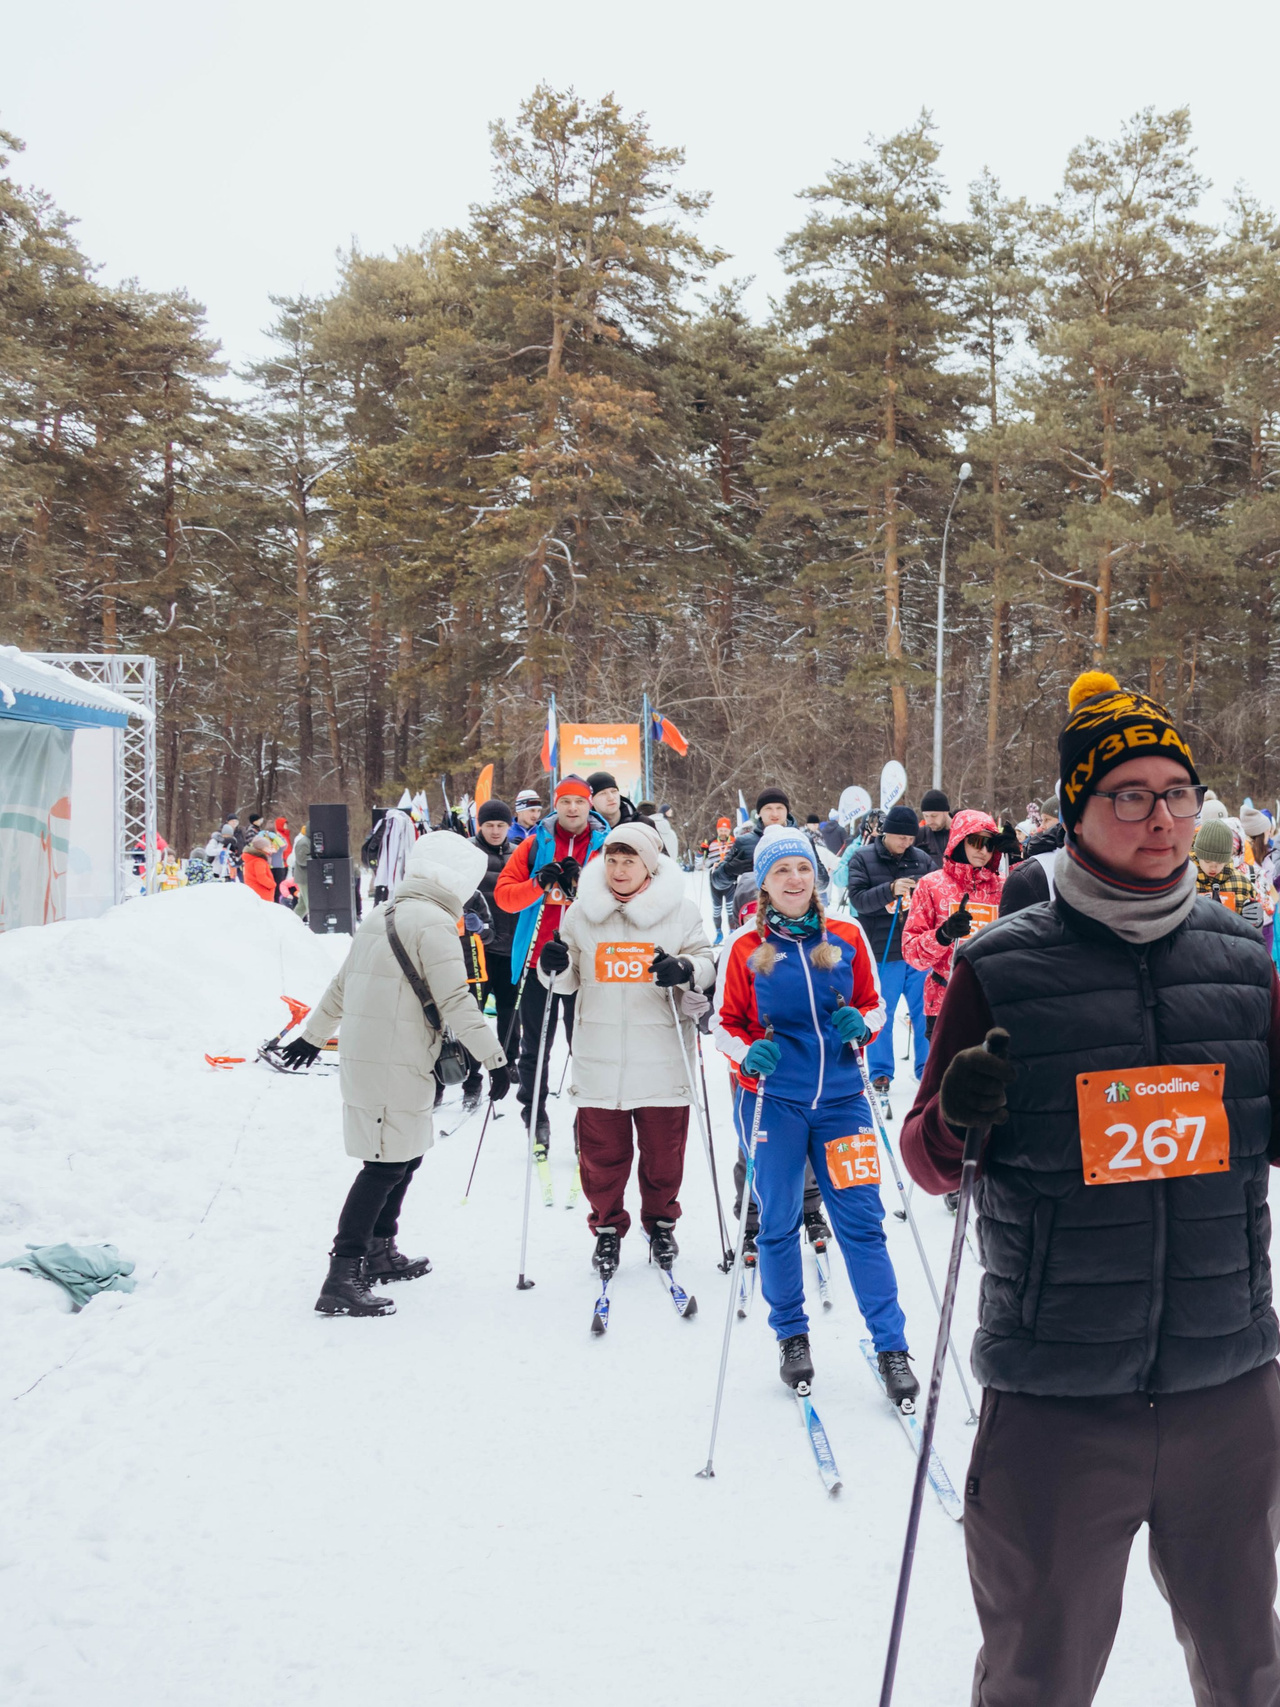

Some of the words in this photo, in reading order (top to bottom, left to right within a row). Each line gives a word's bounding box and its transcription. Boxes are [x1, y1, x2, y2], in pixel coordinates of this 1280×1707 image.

[573, 734, 628, 745] Лыжный
[583, 744, 618, 755] забег
[616, 946, 645, 954] Goodline
[604, 961, 643, 979] 109
[1134, 1077, 1200, 1096] Goodline
[1104, 1116, 1206, 1170] 267
[841, 1157, 879, 1182] 153
[811, 1431, 832, 1462] NORDWAY
